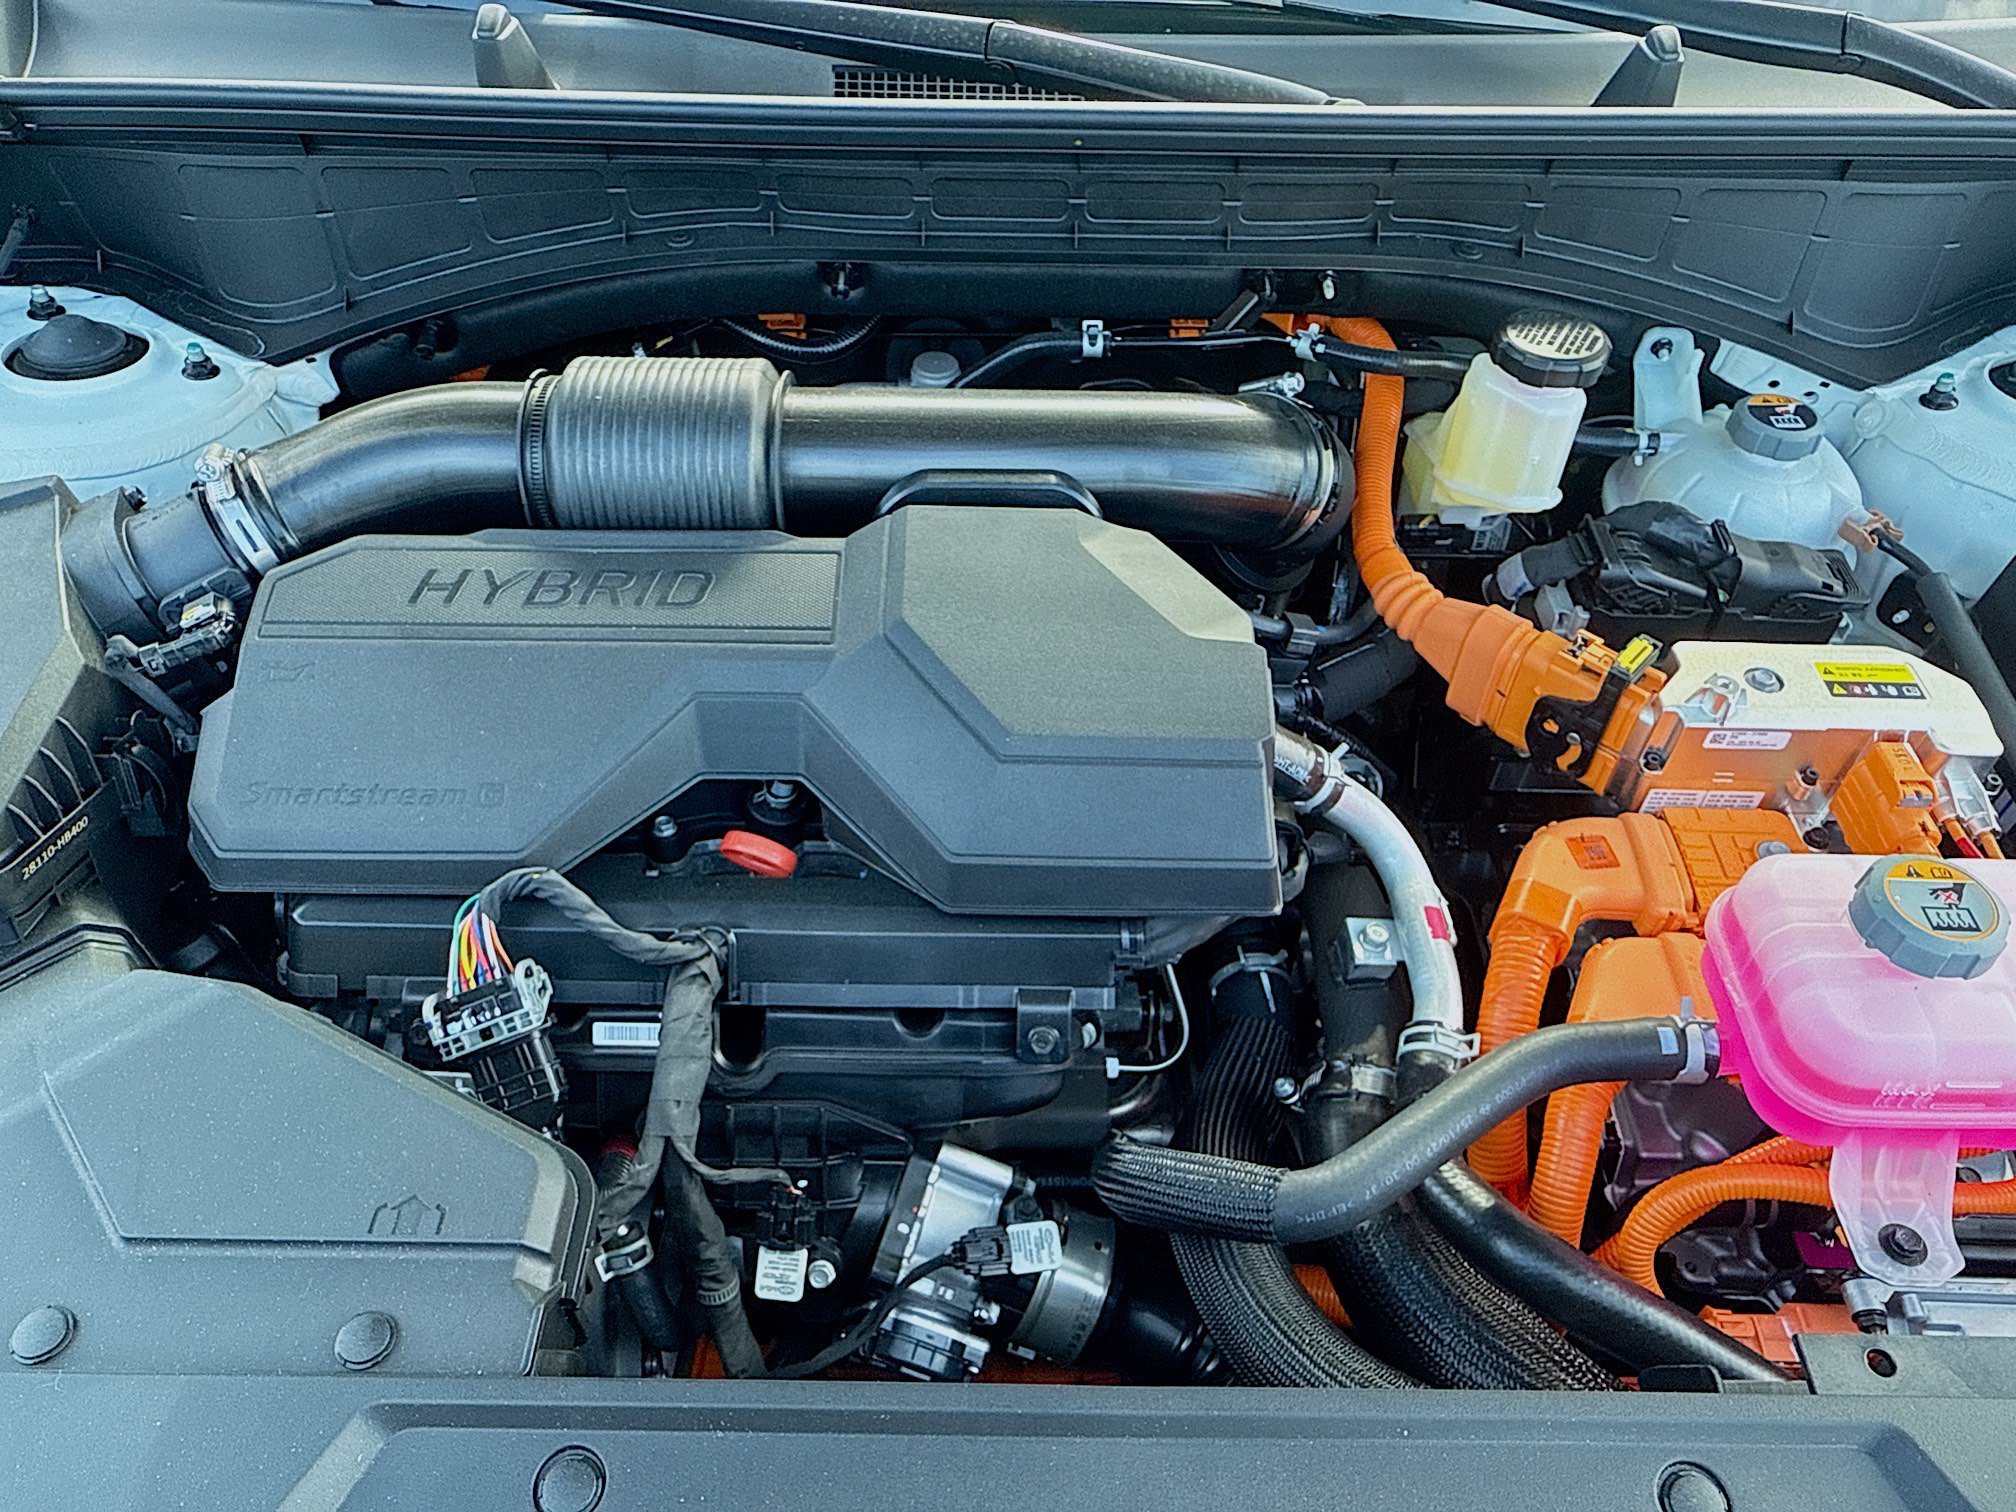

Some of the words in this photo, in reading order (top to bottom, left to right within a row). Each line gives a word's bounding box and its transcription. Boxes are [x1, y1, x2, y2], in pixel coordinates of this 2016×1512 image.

[408, 568, 716, 607] HYBRID
[239, 780, 467, 806] Smartstream
[22, 816, 88, 880] 28110-HB400
